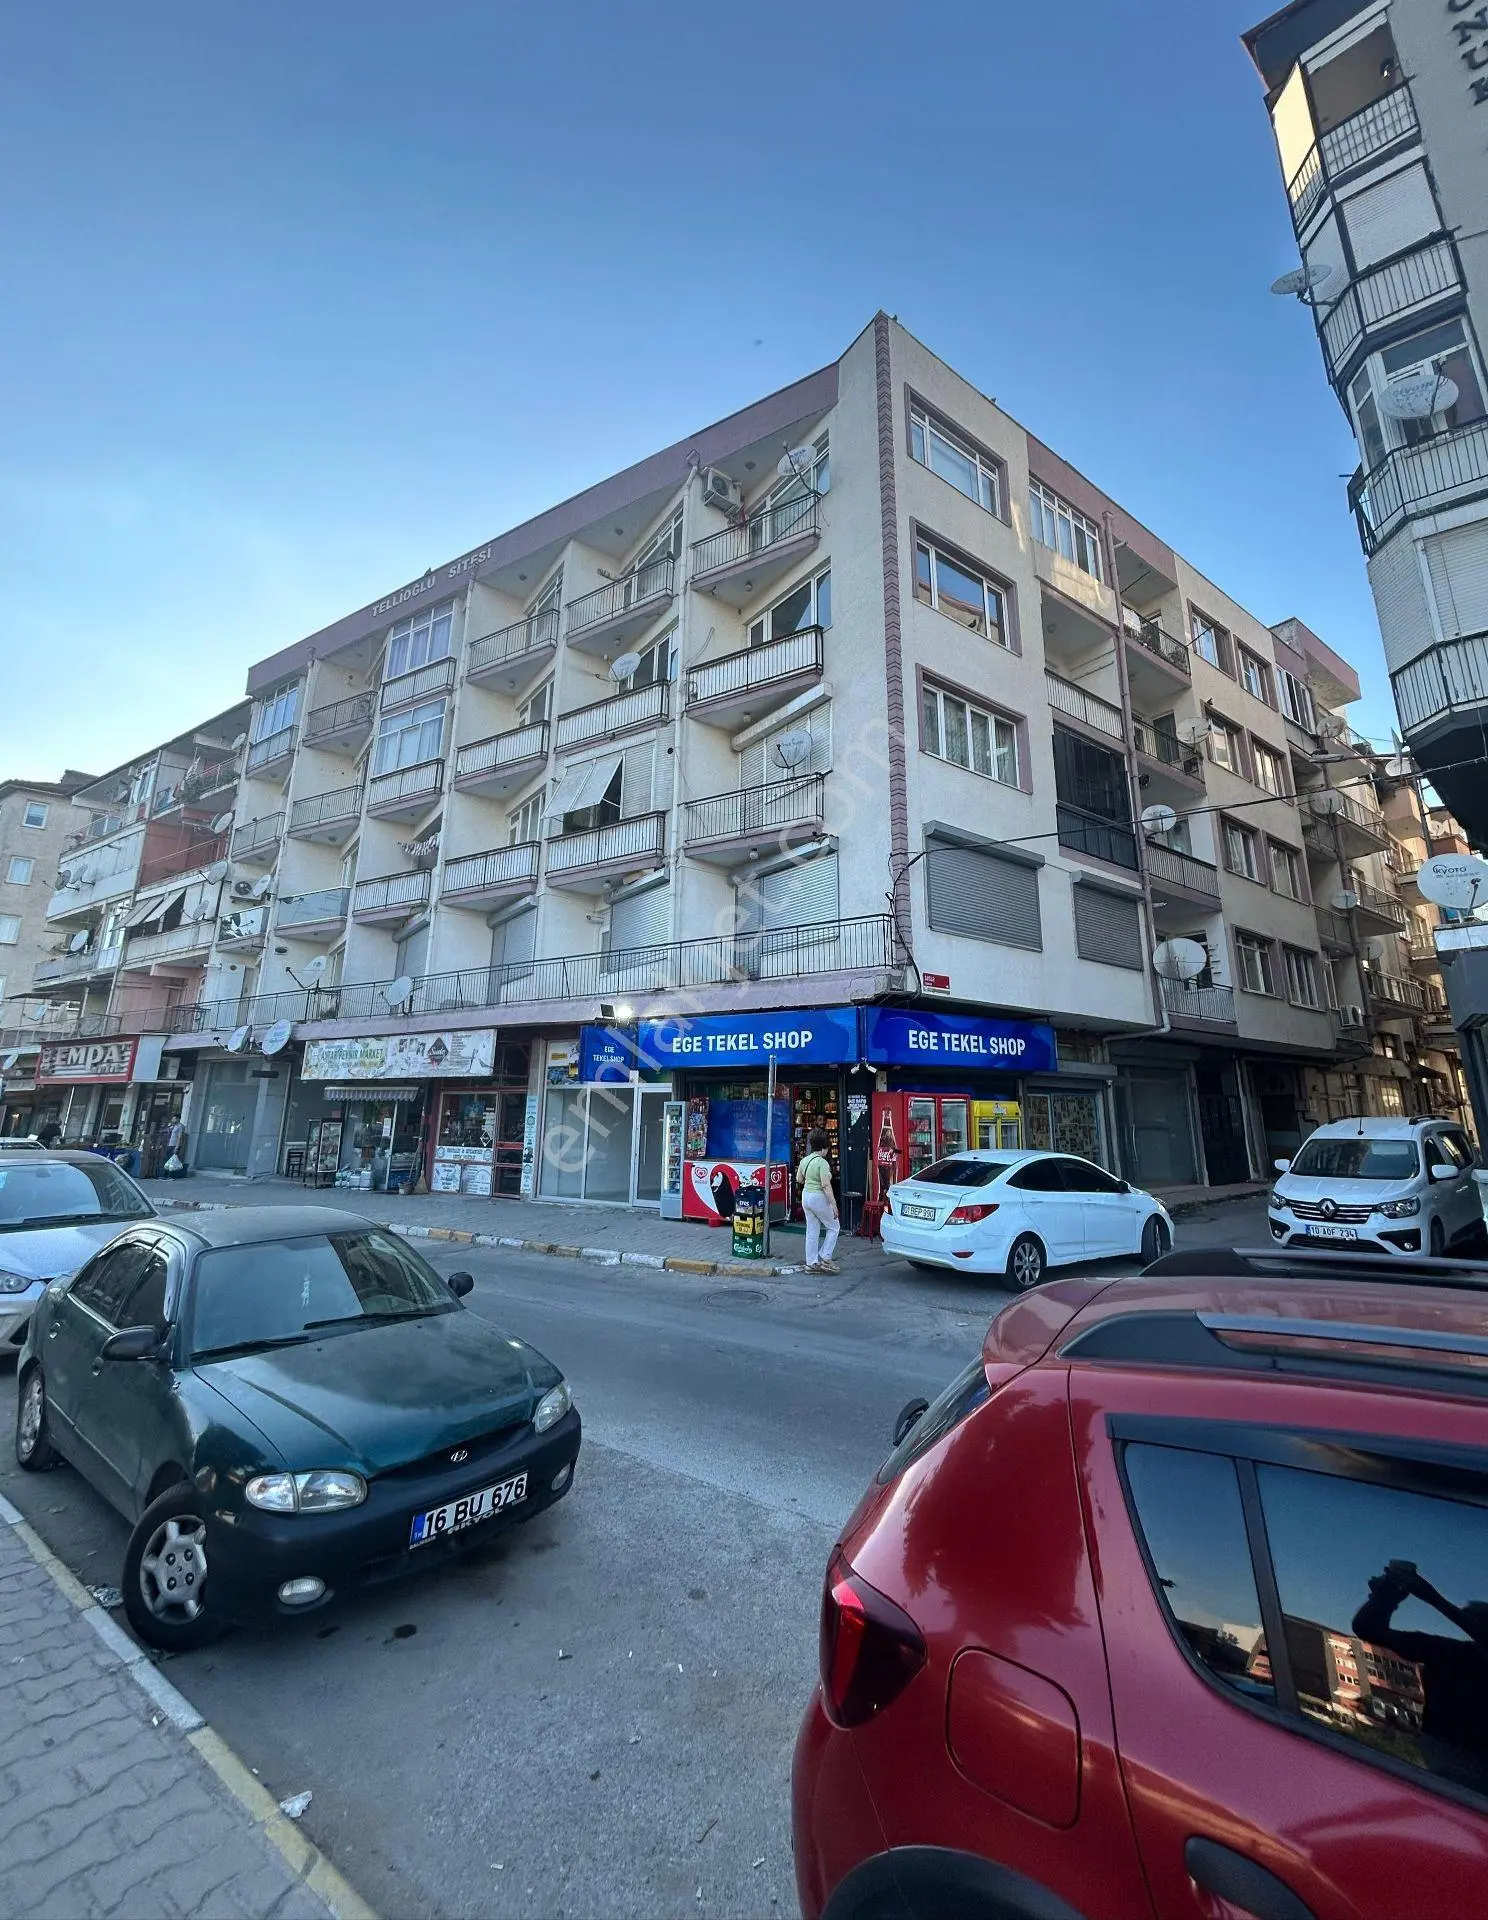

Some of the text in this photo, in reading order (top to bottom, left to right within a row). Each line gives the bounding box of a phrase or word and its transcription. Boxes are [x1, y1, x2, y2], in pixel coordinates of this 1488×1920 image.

[448, 544, 492, 578] SİTESİ
[604, 1045, 615, 1053] EGE
[672, 1030, 813, 1053] EGE TEKEL SHOP
[908, 1029, 1026, 1056] EGE TEKEL SHOP
[593, 1054, 608, 1062] TEKEL
[426, 1477, 526, 1537] 16 BU 676
